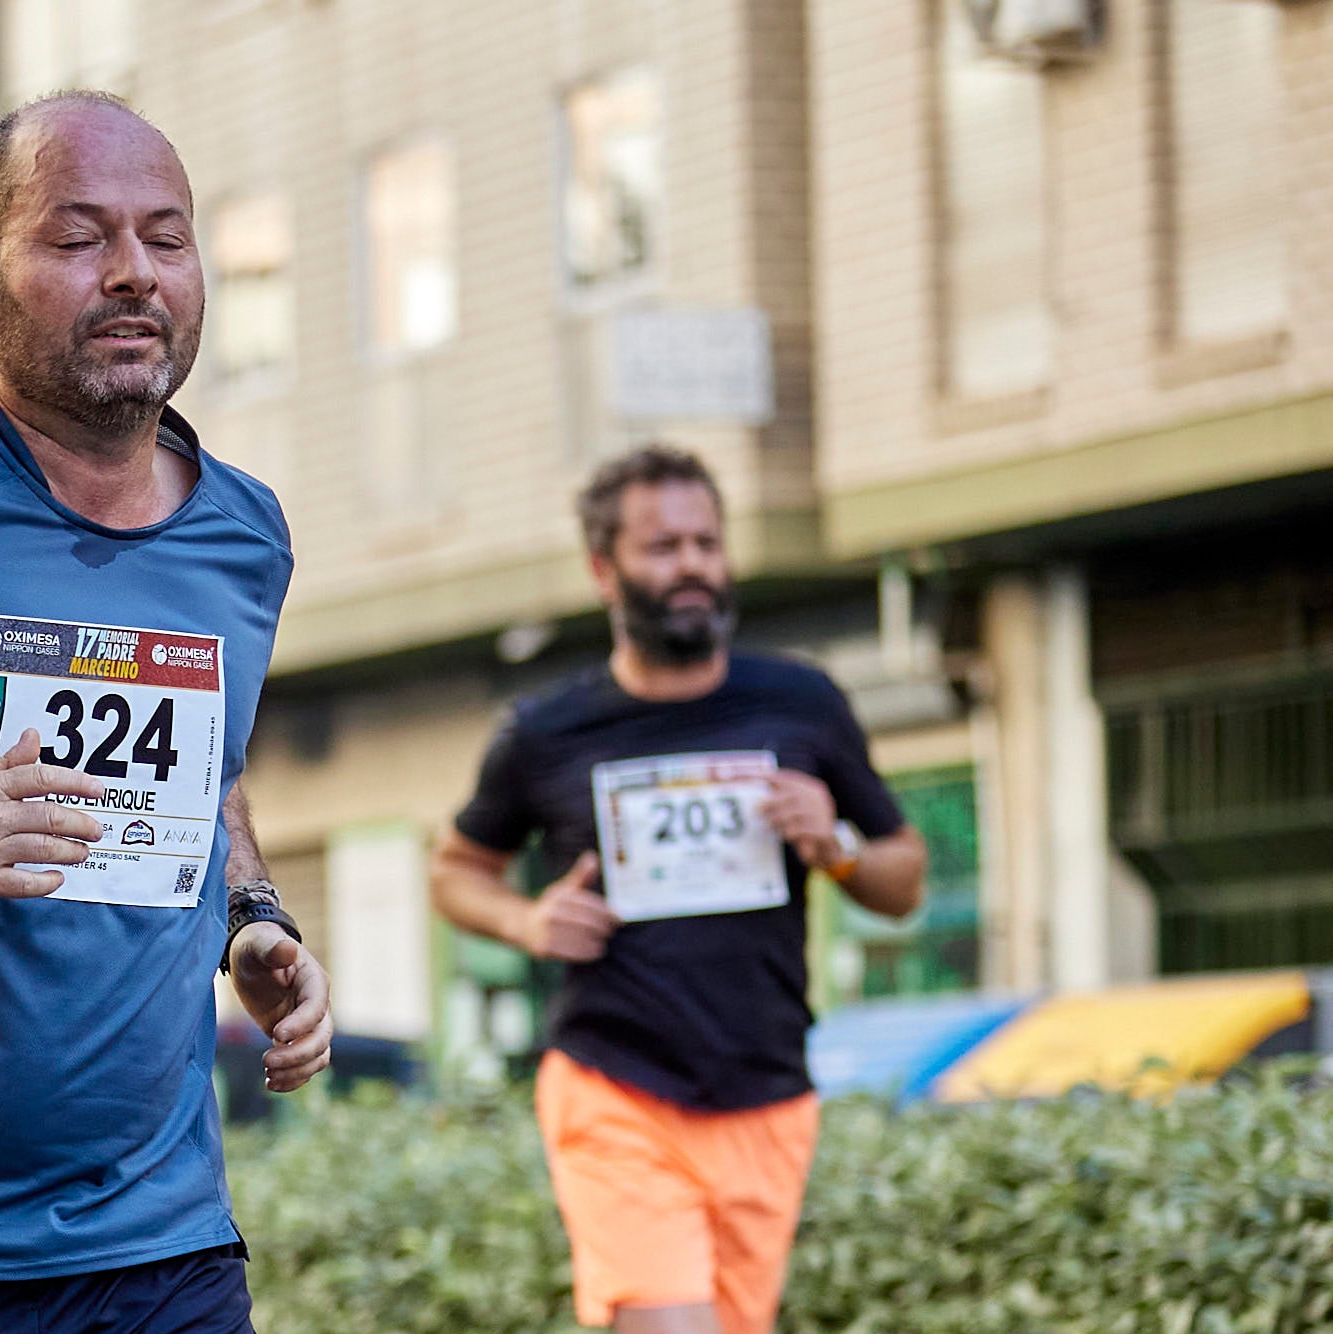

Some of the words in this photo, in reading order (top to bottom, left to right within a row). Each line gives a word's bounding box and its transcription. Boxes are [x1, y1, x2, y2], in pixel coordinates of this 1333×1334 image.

[4, 630, 60, 646] OXIMESA
[74, 628, 100, 658] 17
[98, 630, 139, 646] MEMORIAL
[2, 644, 34, 653] NIPPON
[36, 646, 60, 656] GASES
[97, 642, 136, 662] PADRE
[168, 646, 214, 660] OXIMESA
[69, 657, 139, 680] MARCELINO
[168, 660, 192, 668] NIPPON
[194, 662, 214, 670] GASES
[39, 689, 178, 782] 324
[652, 797, 744, 844] 203
